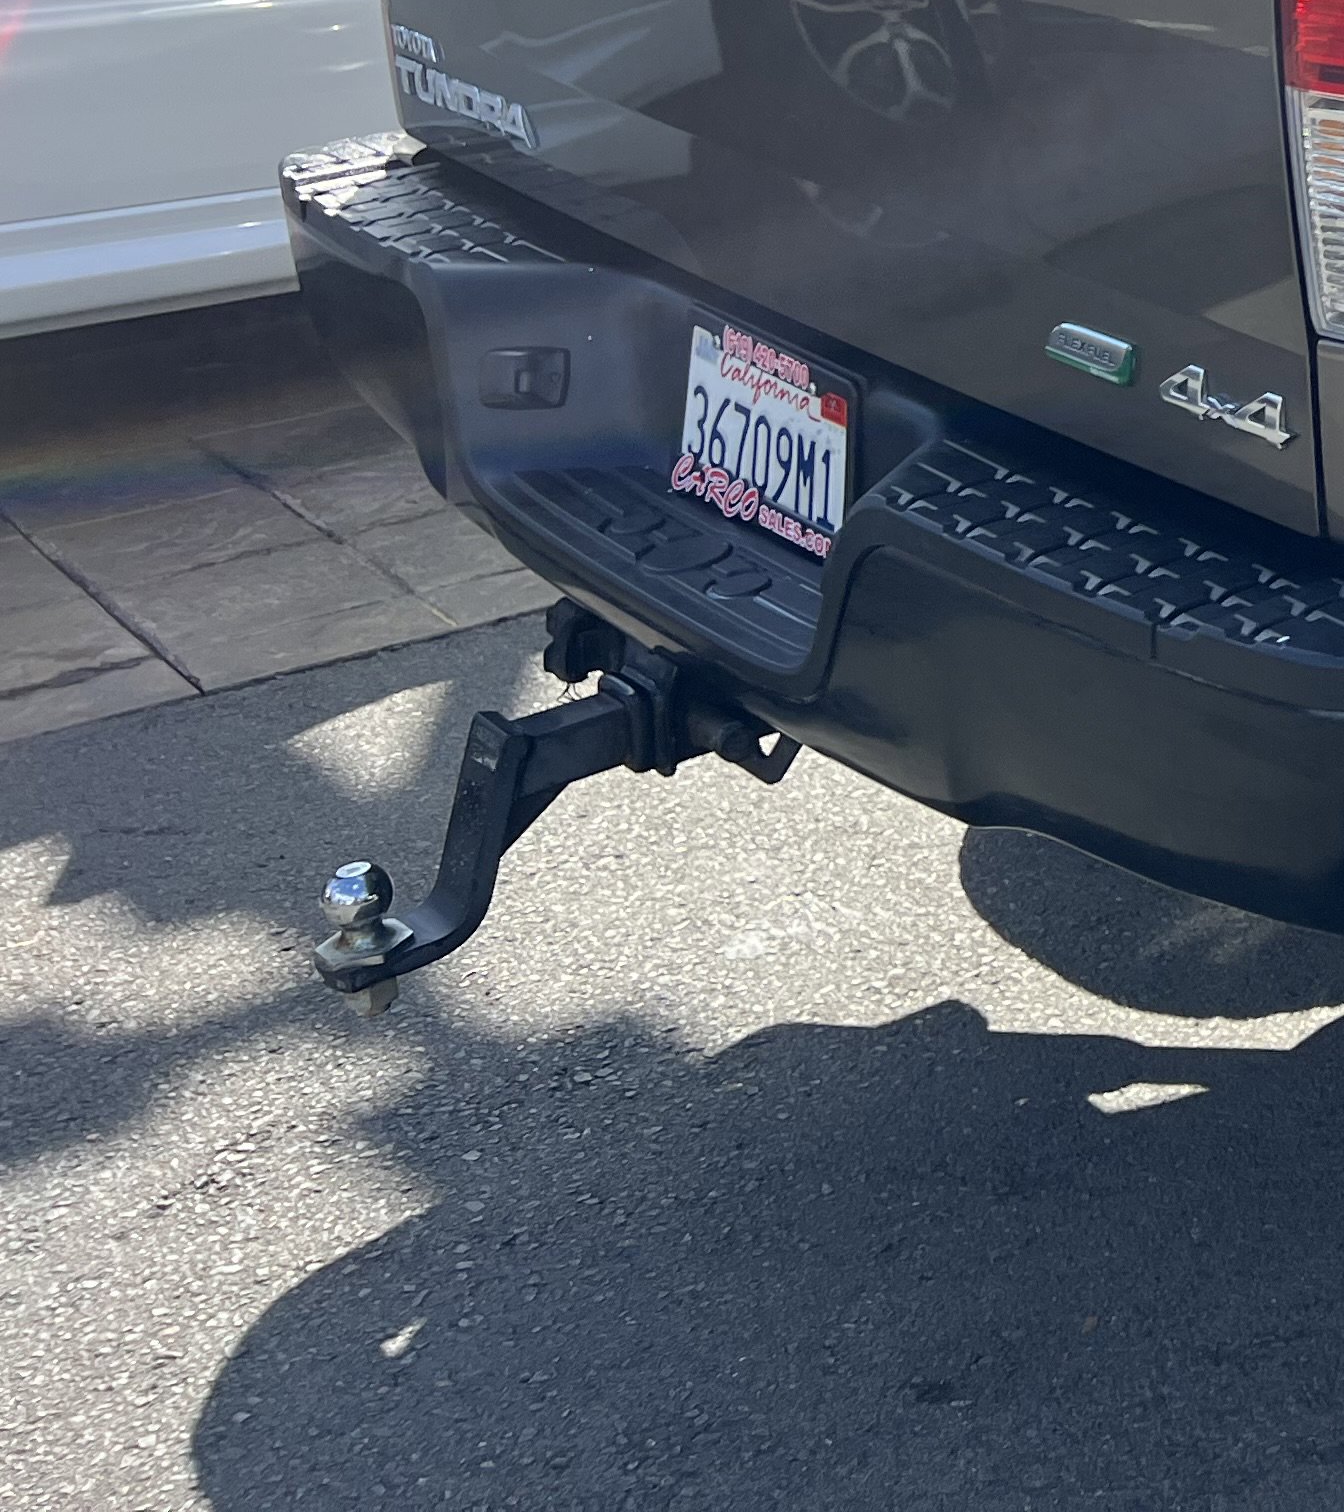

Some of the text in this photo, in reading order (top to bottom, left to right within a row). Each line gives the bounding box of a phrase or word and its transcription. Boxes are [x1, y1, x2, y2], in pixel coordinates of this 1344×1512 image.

[396, 54, 539, 149] TUNDRA
[721, 351, 822, 423] California
[688, 385, 835, 534] 36709M1
